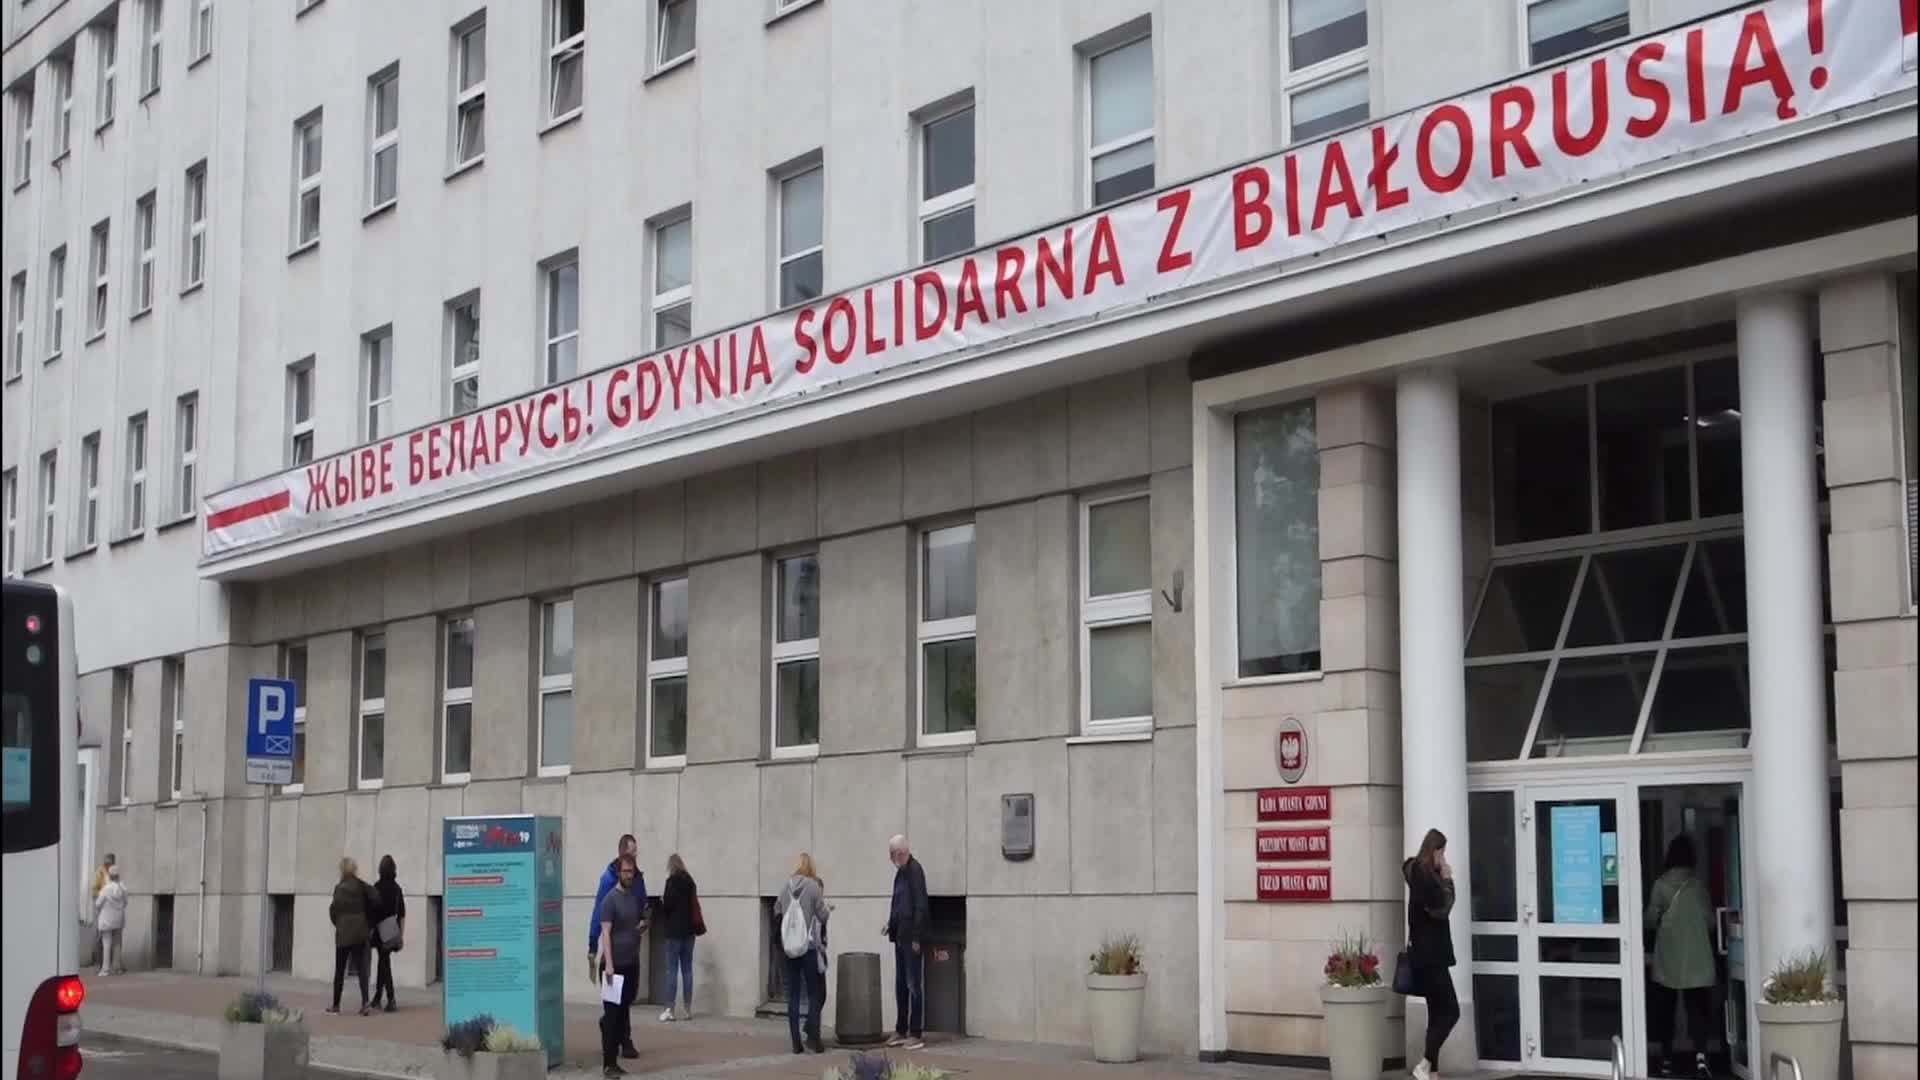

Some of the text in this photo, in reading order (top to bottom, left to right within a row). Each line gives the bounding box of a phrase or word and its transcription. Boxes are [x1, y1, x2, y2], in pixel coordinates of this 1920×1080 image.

[606, 0, 1829, 428] GDYNIA SOLIDARNA Z BIAŁORUSIĄ!
[306, 380, 593, 514] ЖЫВЕ БЕЛАРУСЬ!
[259, 686, 285, 735] P
